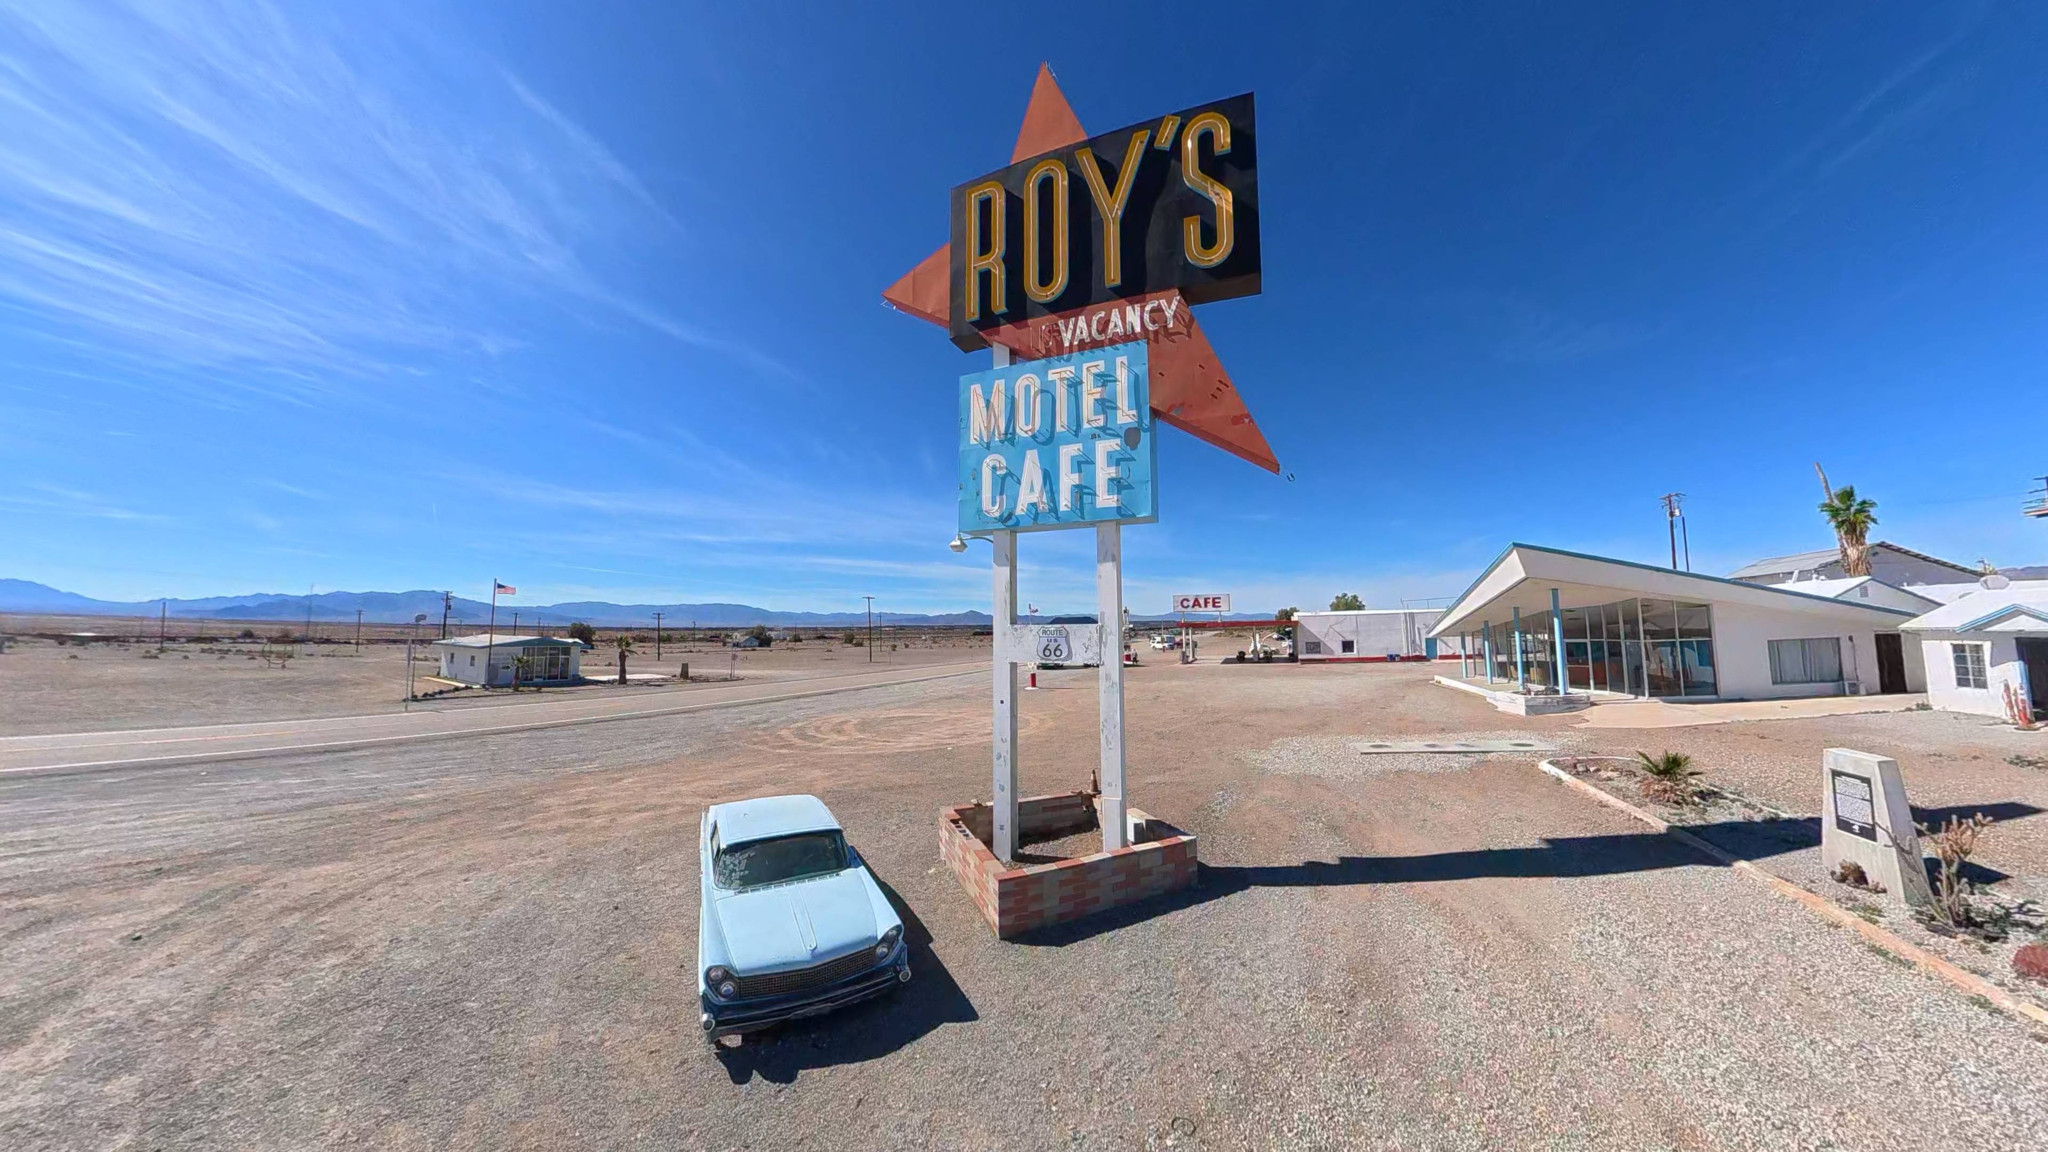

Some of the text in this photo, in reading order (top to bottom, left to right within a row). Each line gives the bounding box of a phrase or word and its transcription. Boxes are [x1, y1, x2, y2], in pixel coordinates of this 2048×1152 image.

[965, 111, 1234, 322] ROY'S
[1058, 296, 1180, 347] VACANCY
[970, 355, 1138, 445] MOTEL
[981, 438, 1122, 518] CAFE
[1180, 596, 1222, 609] CAFE
[1042, 643, 1063, 658] 66
